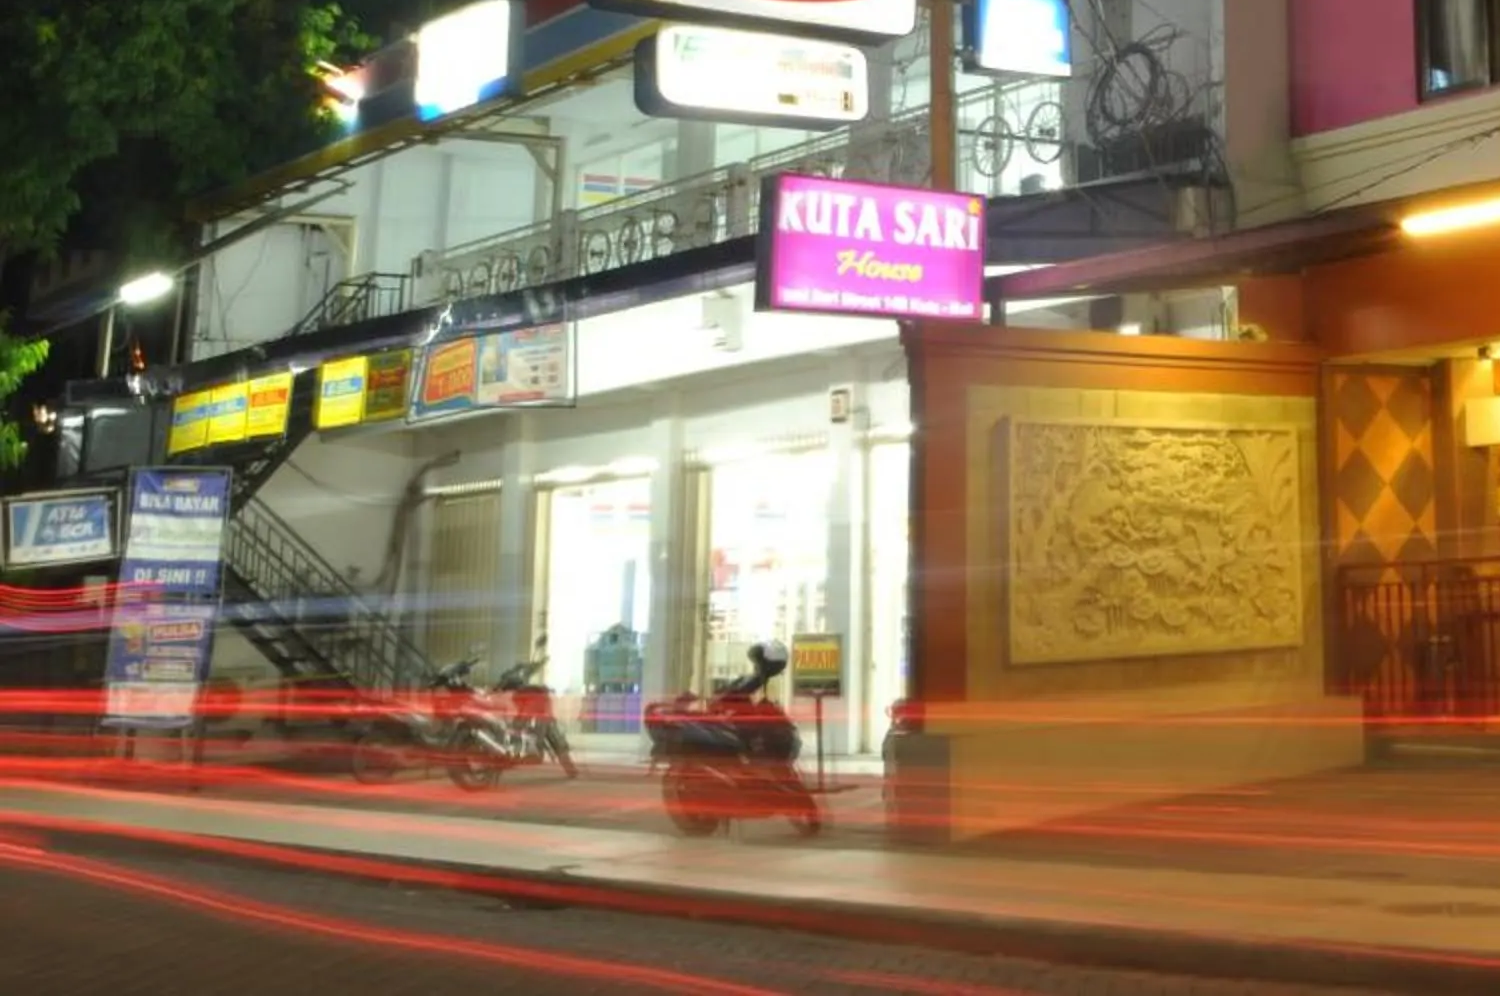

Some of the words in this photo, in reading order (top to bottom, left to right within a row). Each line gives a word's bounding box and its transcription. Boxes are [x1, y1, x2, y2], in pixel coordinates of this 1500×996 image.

[777, 190, 884, 243] KUTA
[836, 249, 924, 283] House
[48, 505, 86, 523] ATM
